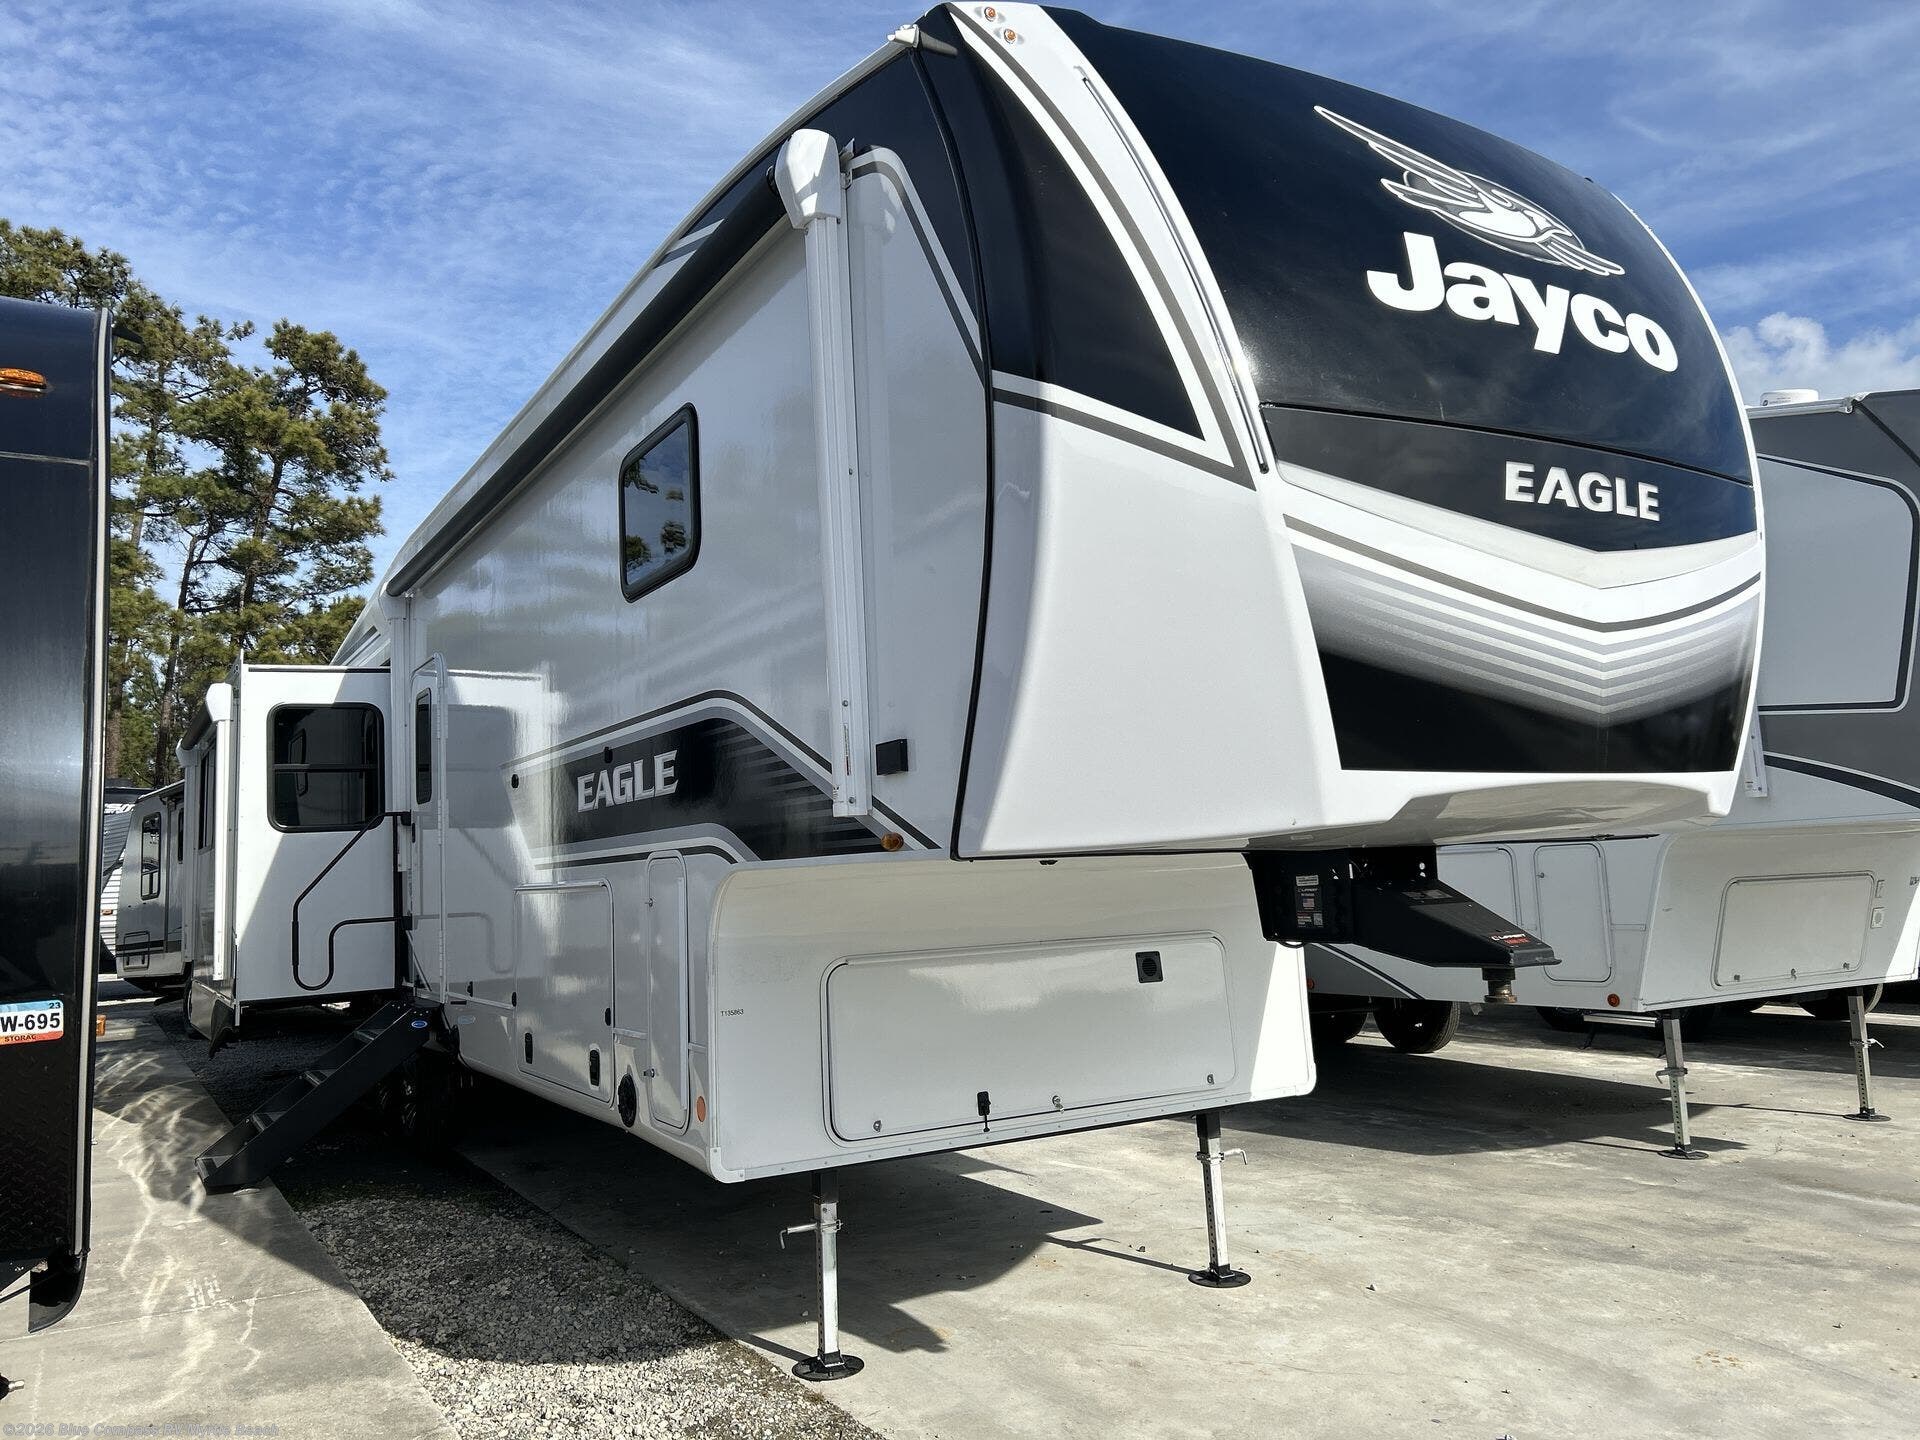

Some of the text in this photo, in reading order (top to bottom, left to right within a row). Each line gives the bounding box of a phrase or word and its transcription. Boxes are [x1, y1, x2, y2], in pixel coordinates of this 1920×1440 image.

[1366, 231, 1678, 372] Jayco
[1504, 461, 1660, 522] EAGLE
[576, 750, 679, 813] EAGLE
[49, 1002, 61, 1010] 23
